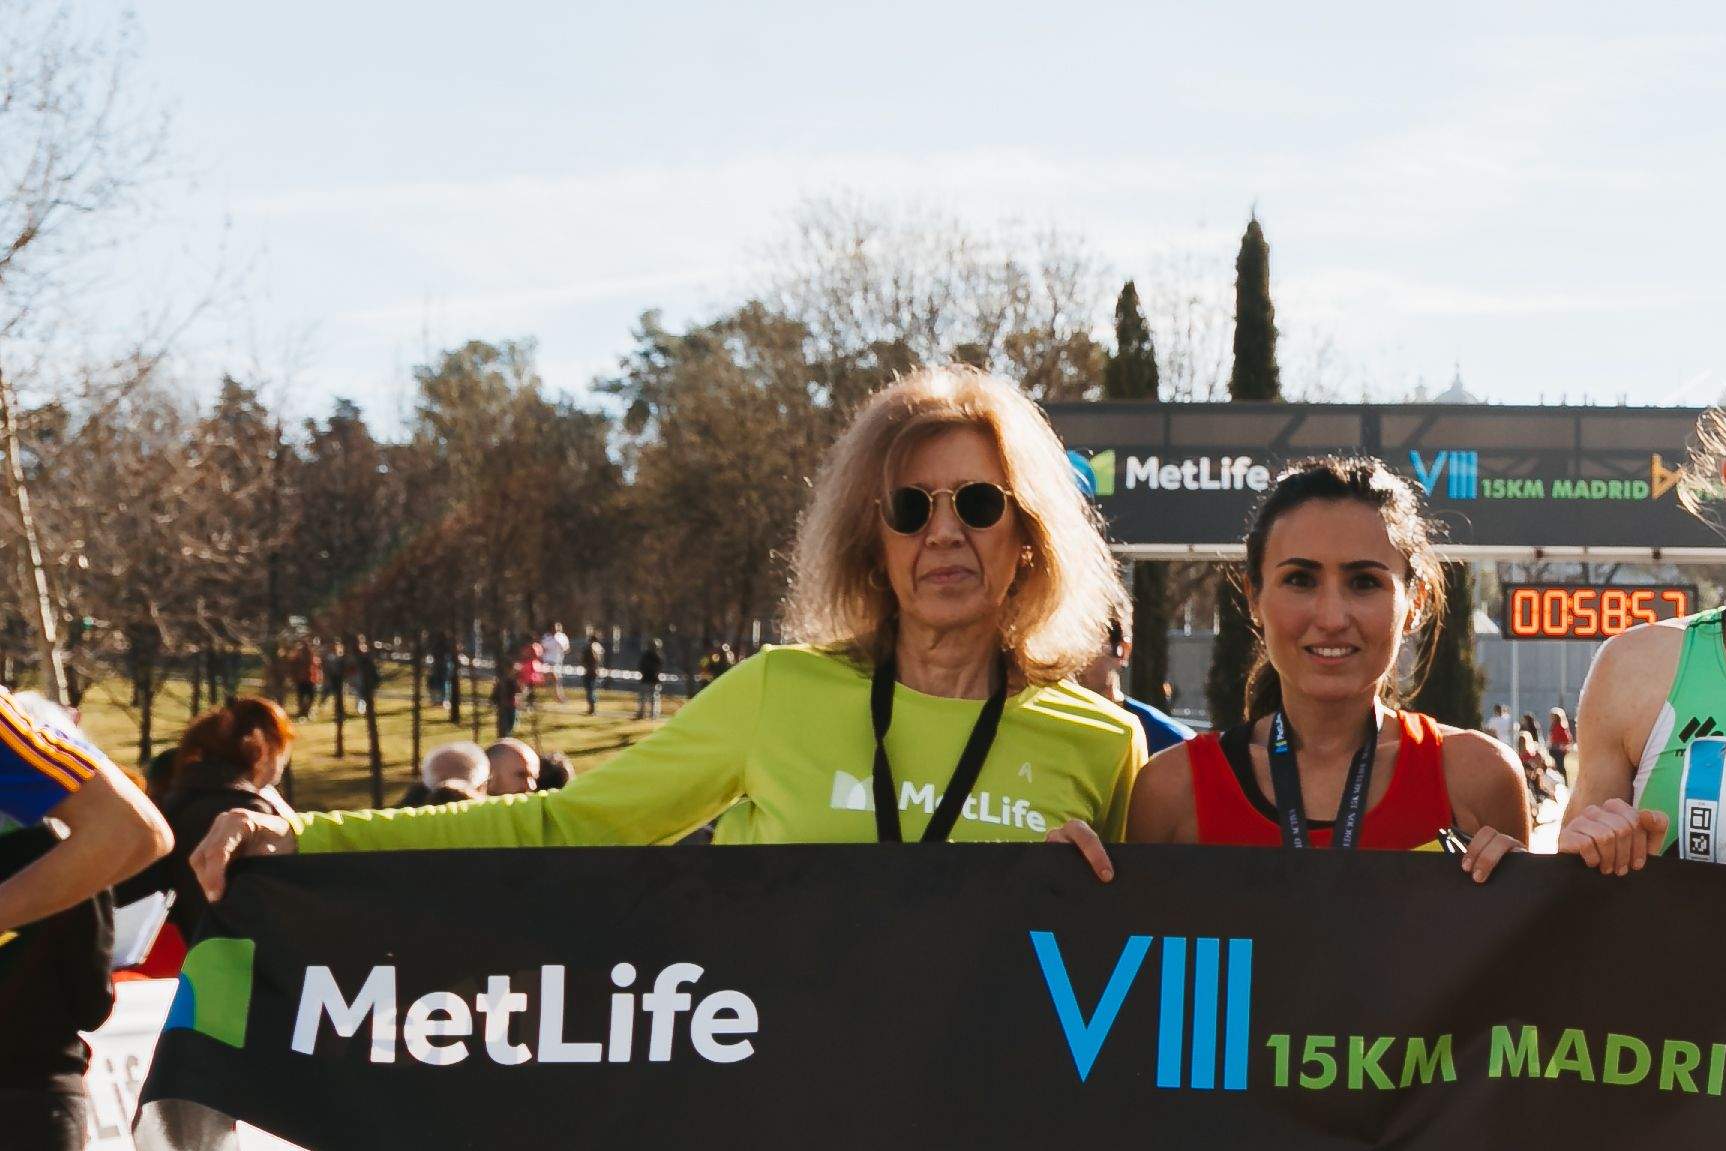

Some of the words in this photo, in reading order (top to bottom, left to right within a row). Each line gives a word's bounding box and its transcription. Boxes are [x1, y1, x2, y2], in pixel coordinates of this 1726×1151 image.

[1125, 456, 1270, 491] MetLife
[1409, 450, 1477, 498] VIII
[1482, 479, 1545, 499] 15KM
[1551, 479, 1649, 499] MADRID
[899, 780, 1047, 832] MtLife
[292, 962, 759, 1065] MetLife
[1030, 931, 1253, 1090] VIII
[1266, 1033, 1456, 1090] 15KM
